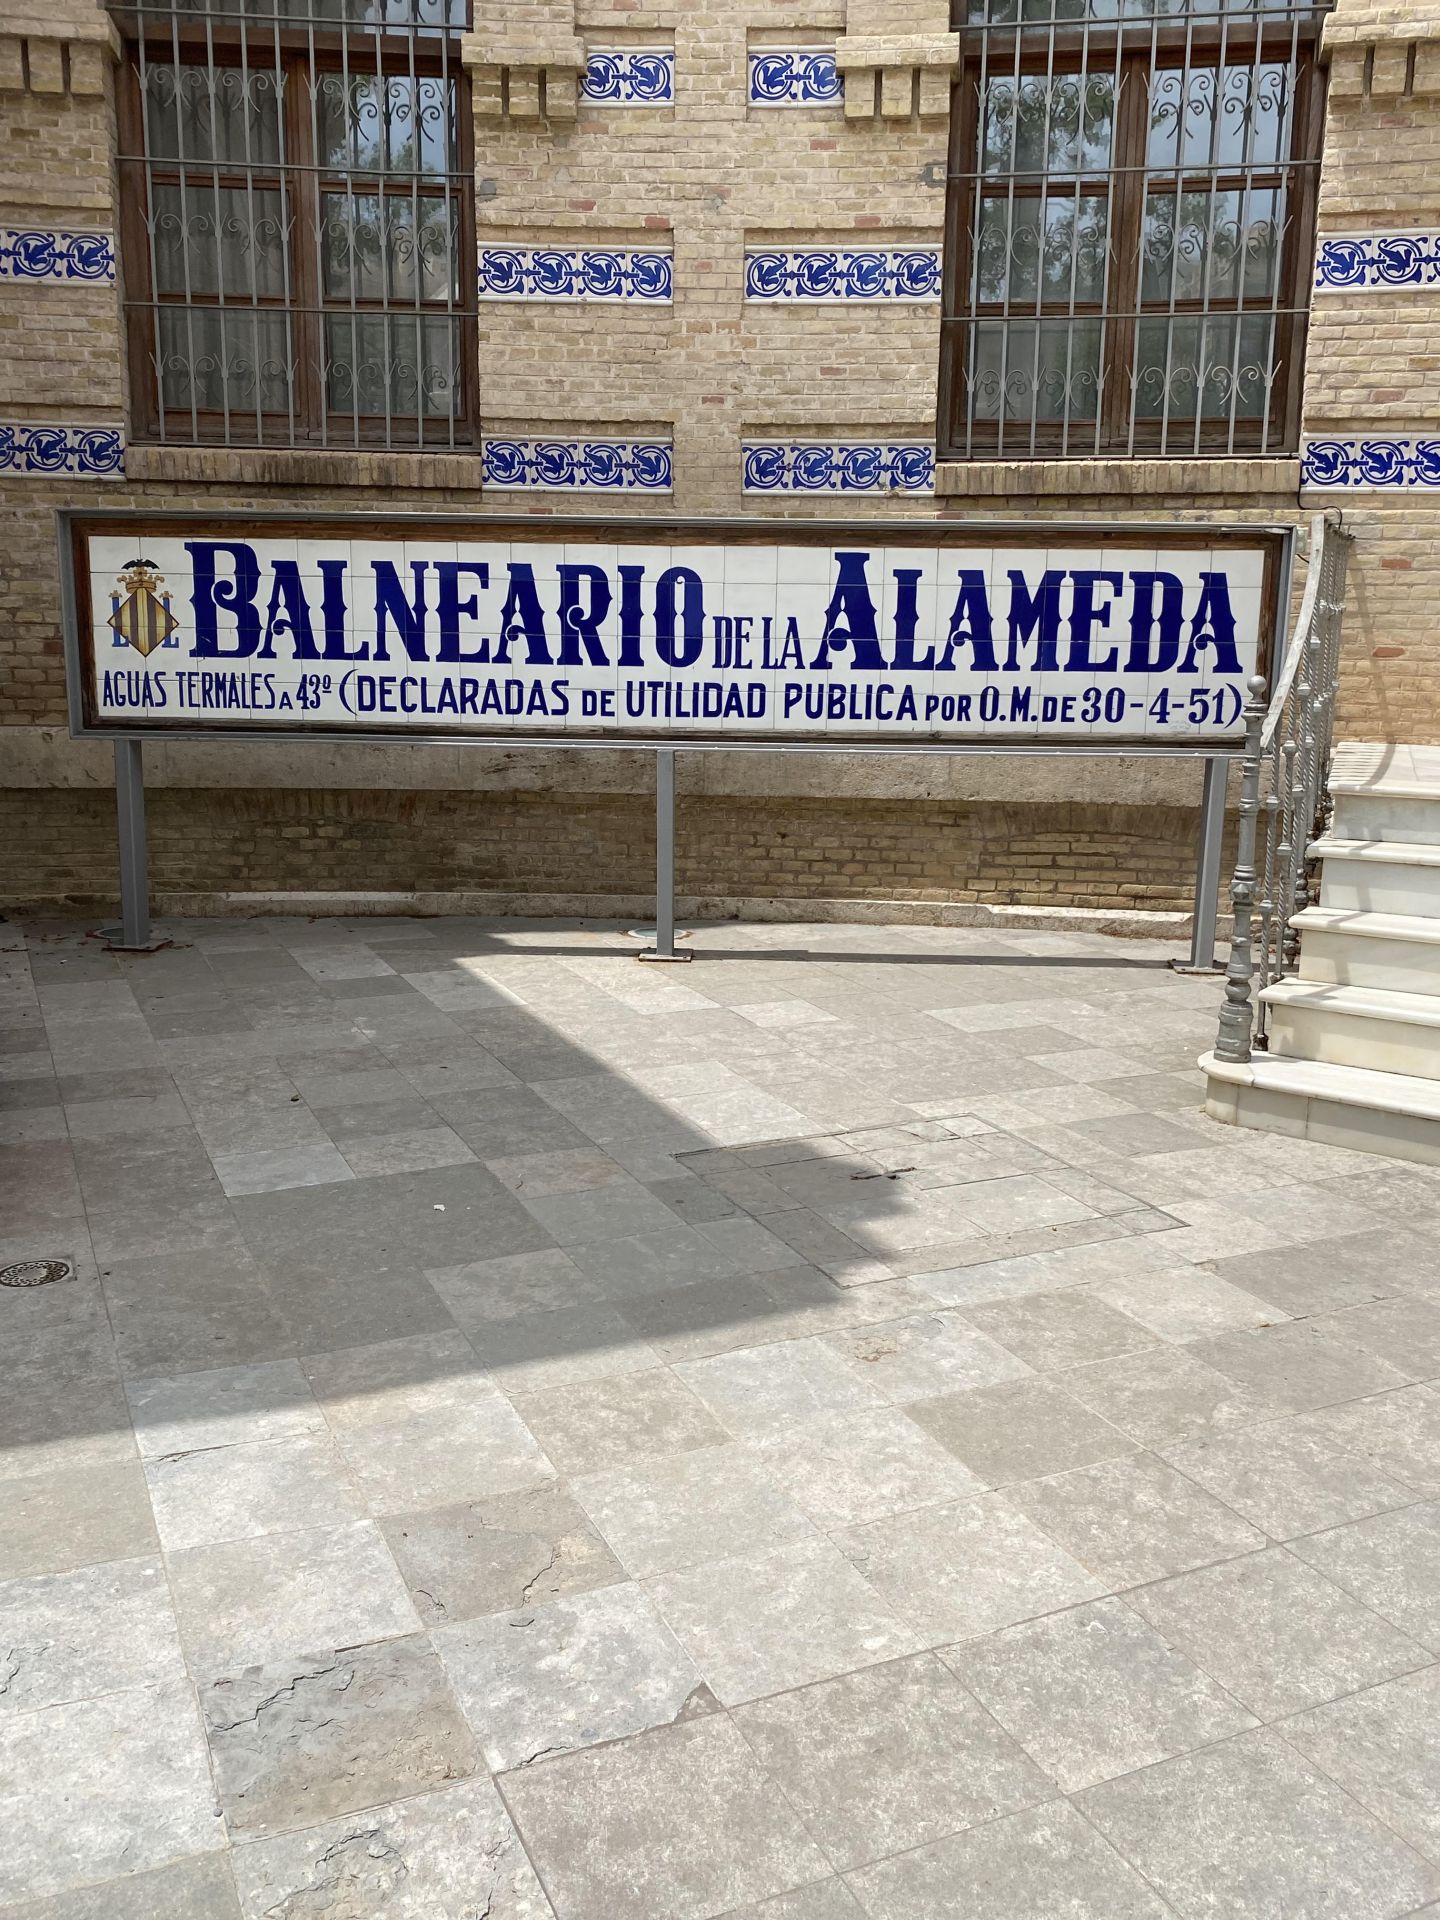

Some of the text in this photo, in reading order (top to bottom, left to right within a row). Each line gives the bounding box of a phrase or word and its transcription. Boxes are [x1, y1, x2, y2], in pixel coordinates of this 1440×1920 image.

[184, 541, 1244, 674] BALNEARIO DE LA ALAMEDA
[103, 670, 167, 709] AGUAS
[175, 671, 276, 709] TERMALES
[279, 690, 293, 710] A
[582, 690, 616, 717] DE
[626, 680, 767, 719] UTILIDAD
[784, 682, 918, 721] PUBLICA
[925, 694, 972, 722] POR
